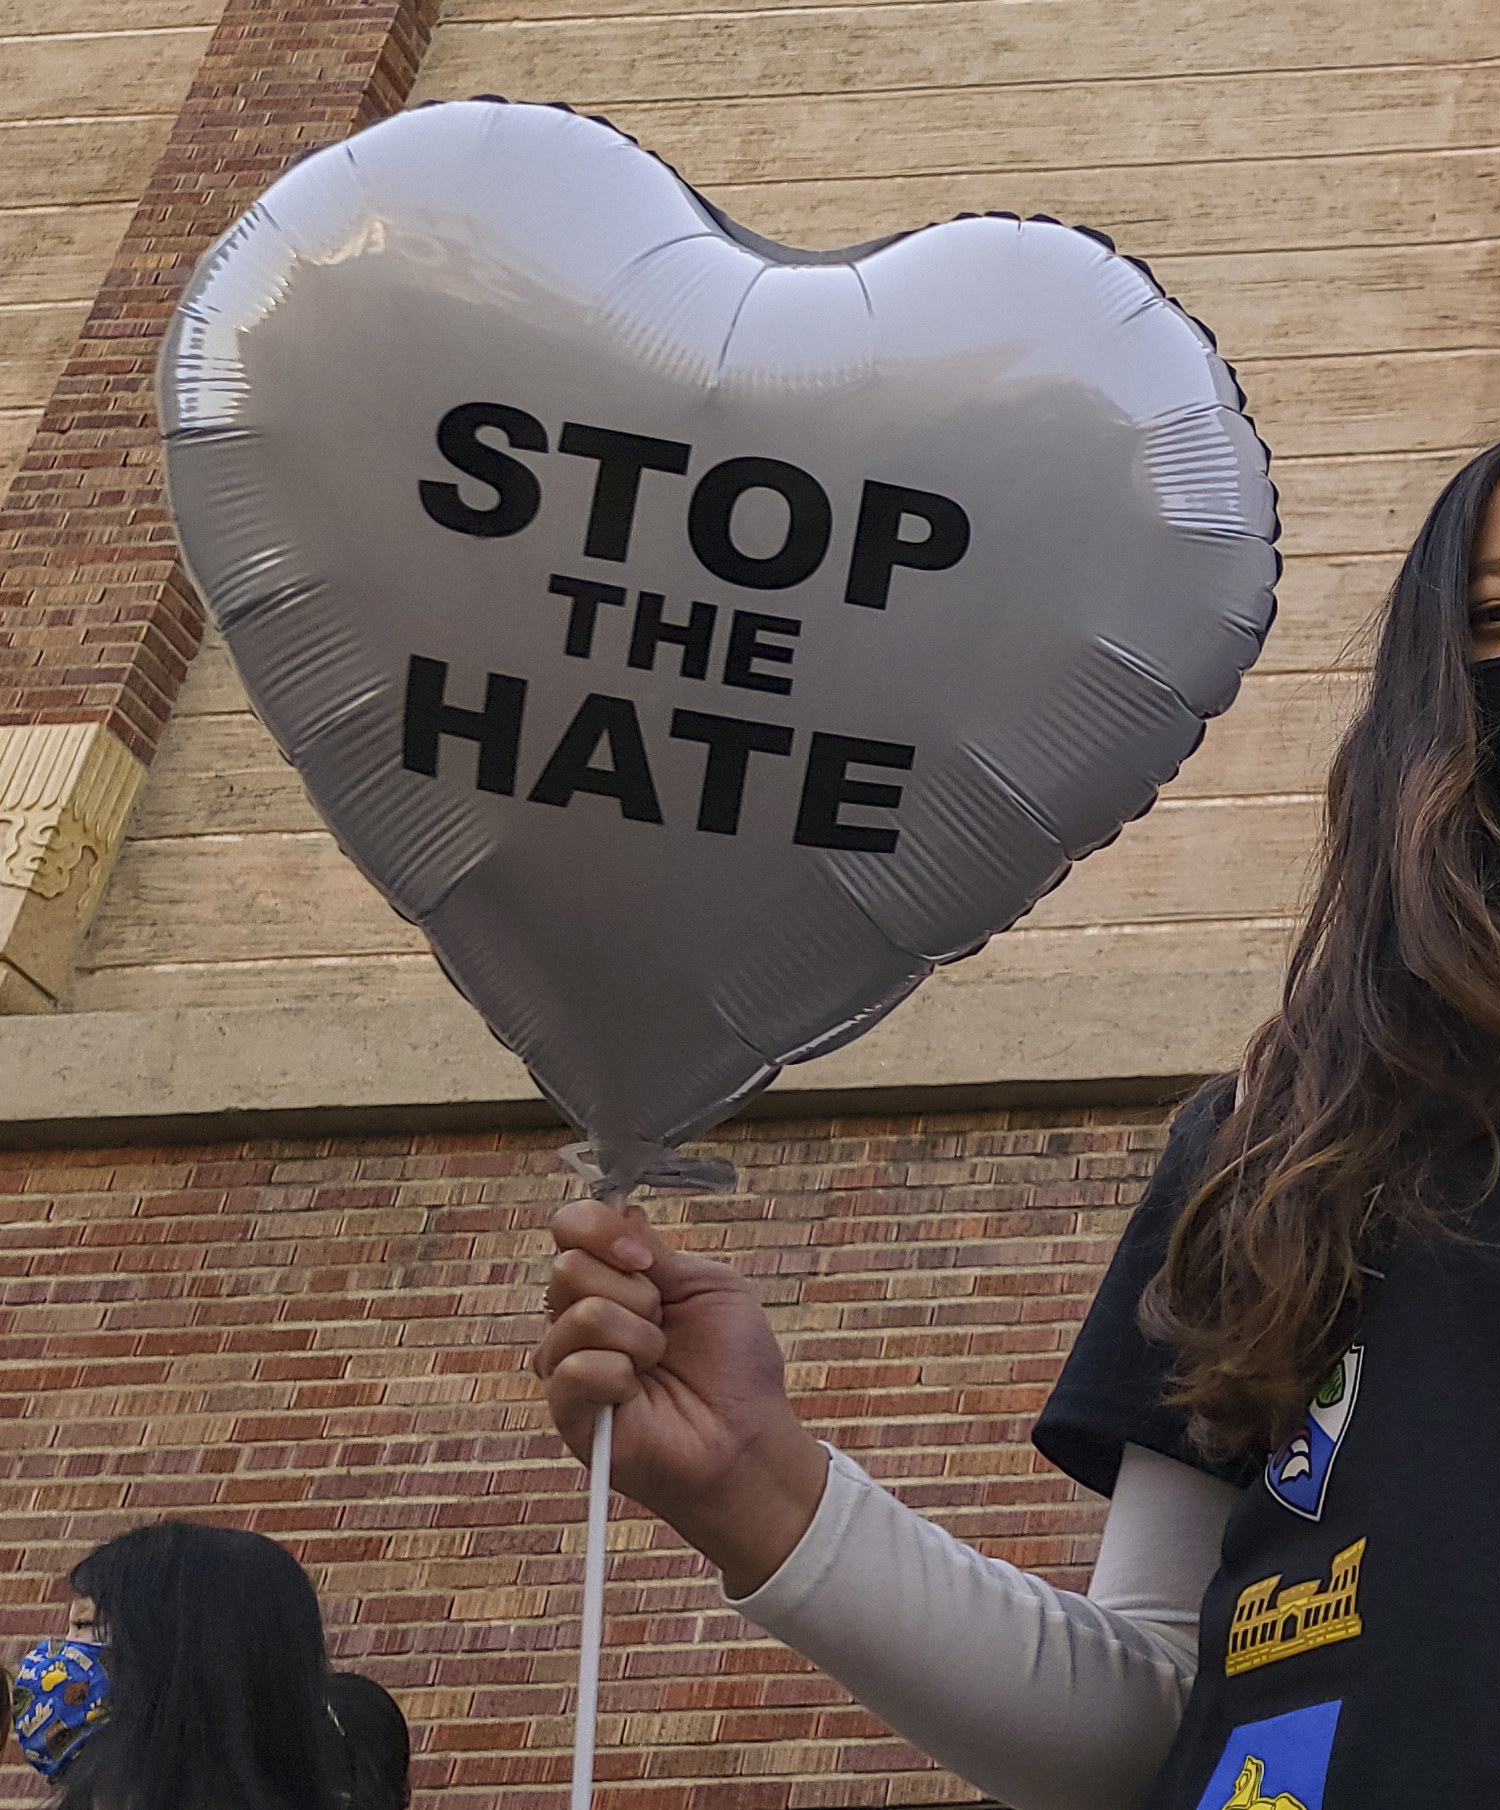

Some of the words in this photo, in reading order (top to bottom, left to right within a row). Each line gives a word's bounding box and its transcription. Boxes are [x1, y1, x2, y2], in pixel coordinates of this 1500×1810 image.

[418, 402, 971, 610] STOP
[548, 573, 802, 696] THE
[403, 653, 916, 854] HATE
